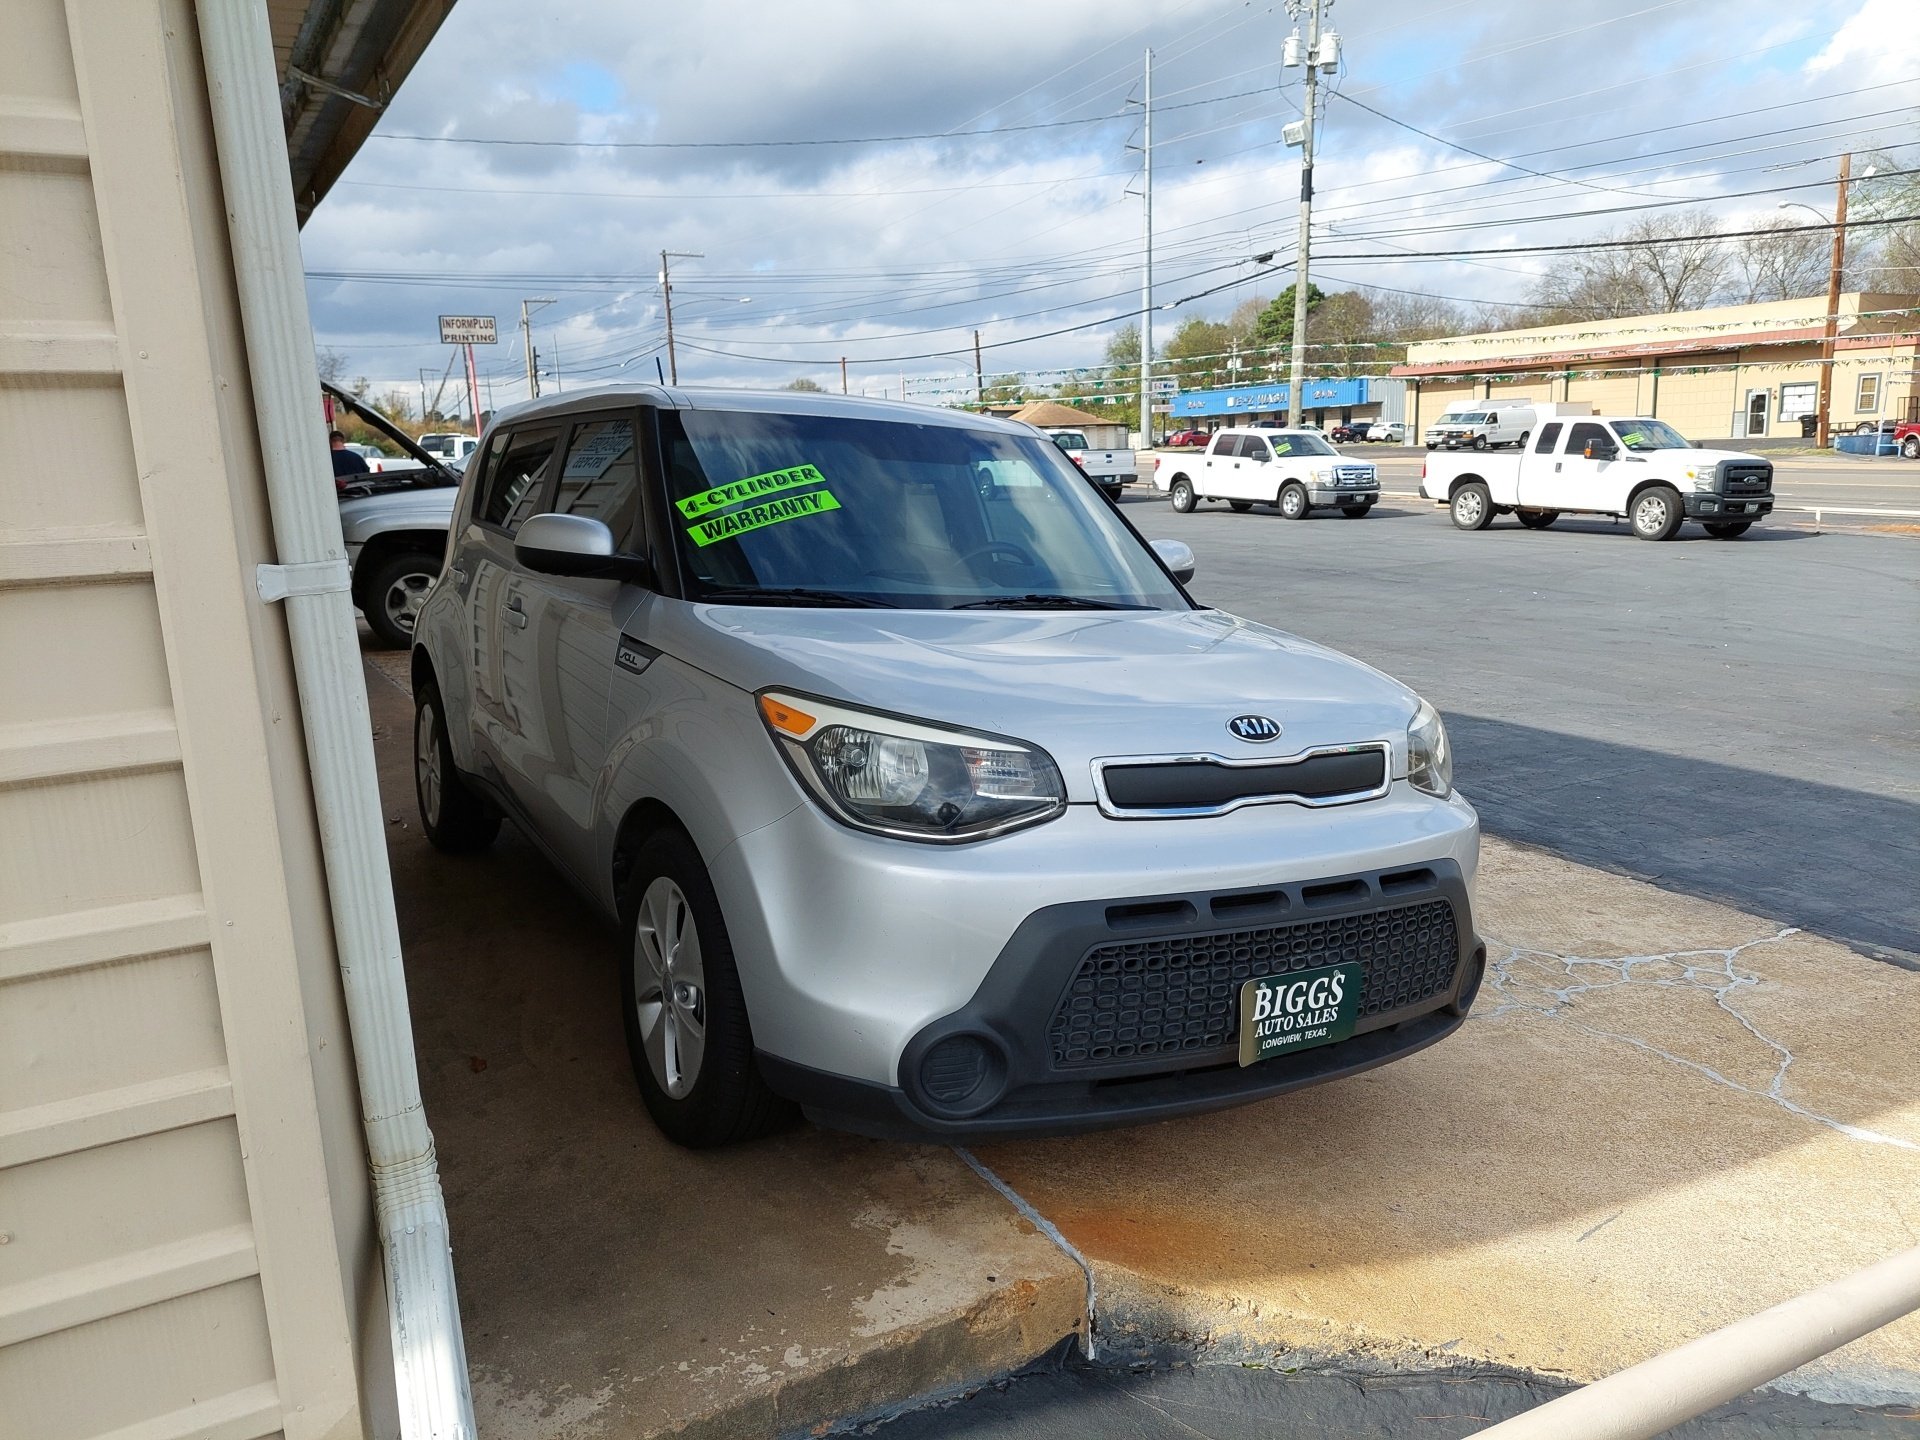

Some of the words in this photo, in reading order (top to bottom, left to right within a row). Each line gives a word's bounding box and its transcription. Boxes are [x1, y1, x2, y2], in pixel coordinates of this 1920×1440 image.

[442, 318, 494, 329] INFORMPLUS
[444, 334, 496, 342] PRINTING
[684, 467, 819, 513] 4-CYLINDER
[700, 493, 823, 540] WARRANTY
[1234, 718, 1277, 736] KIA
[1252, 974, 1346, 1022] BIGGS
[1254, 1015, 1294, 1038] AUTO
[1296, 1006, 1339, 1028] SALES
[1262, 1033, 1302, 1049] LONGVIEW,
[1304, 1027, 1328, 1040] TEXAS
